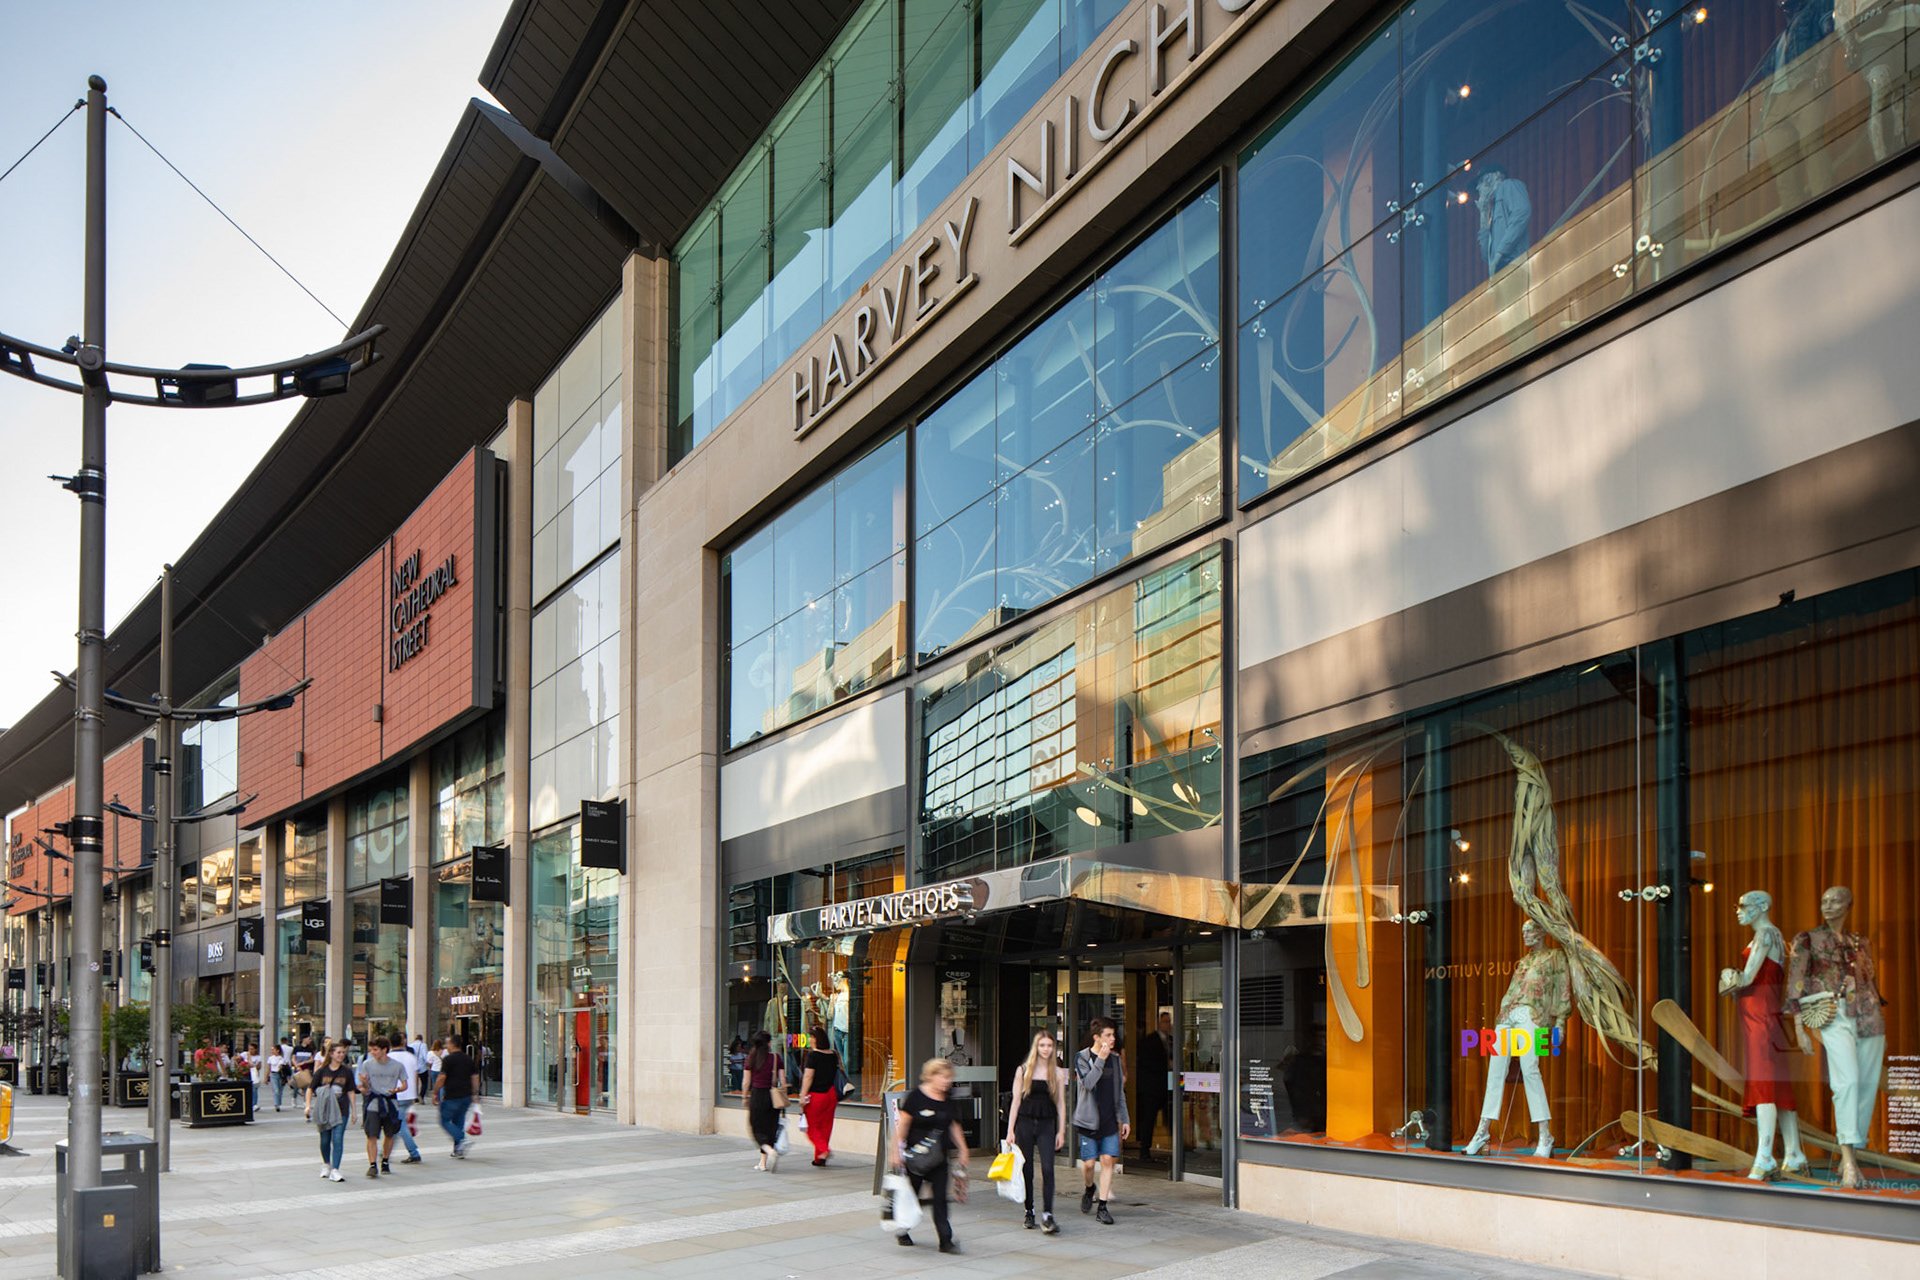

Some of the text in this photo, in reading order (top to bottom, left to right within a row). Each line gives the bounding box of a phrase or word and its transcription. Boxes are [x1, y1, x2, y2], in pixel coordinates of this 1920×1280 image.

[793, 0, 1254, 432] HARVEY NICH
[393, 548, 421, 599] NEW
[393, 553, 459, 633] CATHEDRAL
[392, 613, 431, 670] STREET
[304, 918, 325, 928] UGG
[819, 883, 959, 931] HARVEY NICHOLS
[207, 941, 224, 958] BOSS
[1460, 1027, 1561, 1057] PRIDE!
